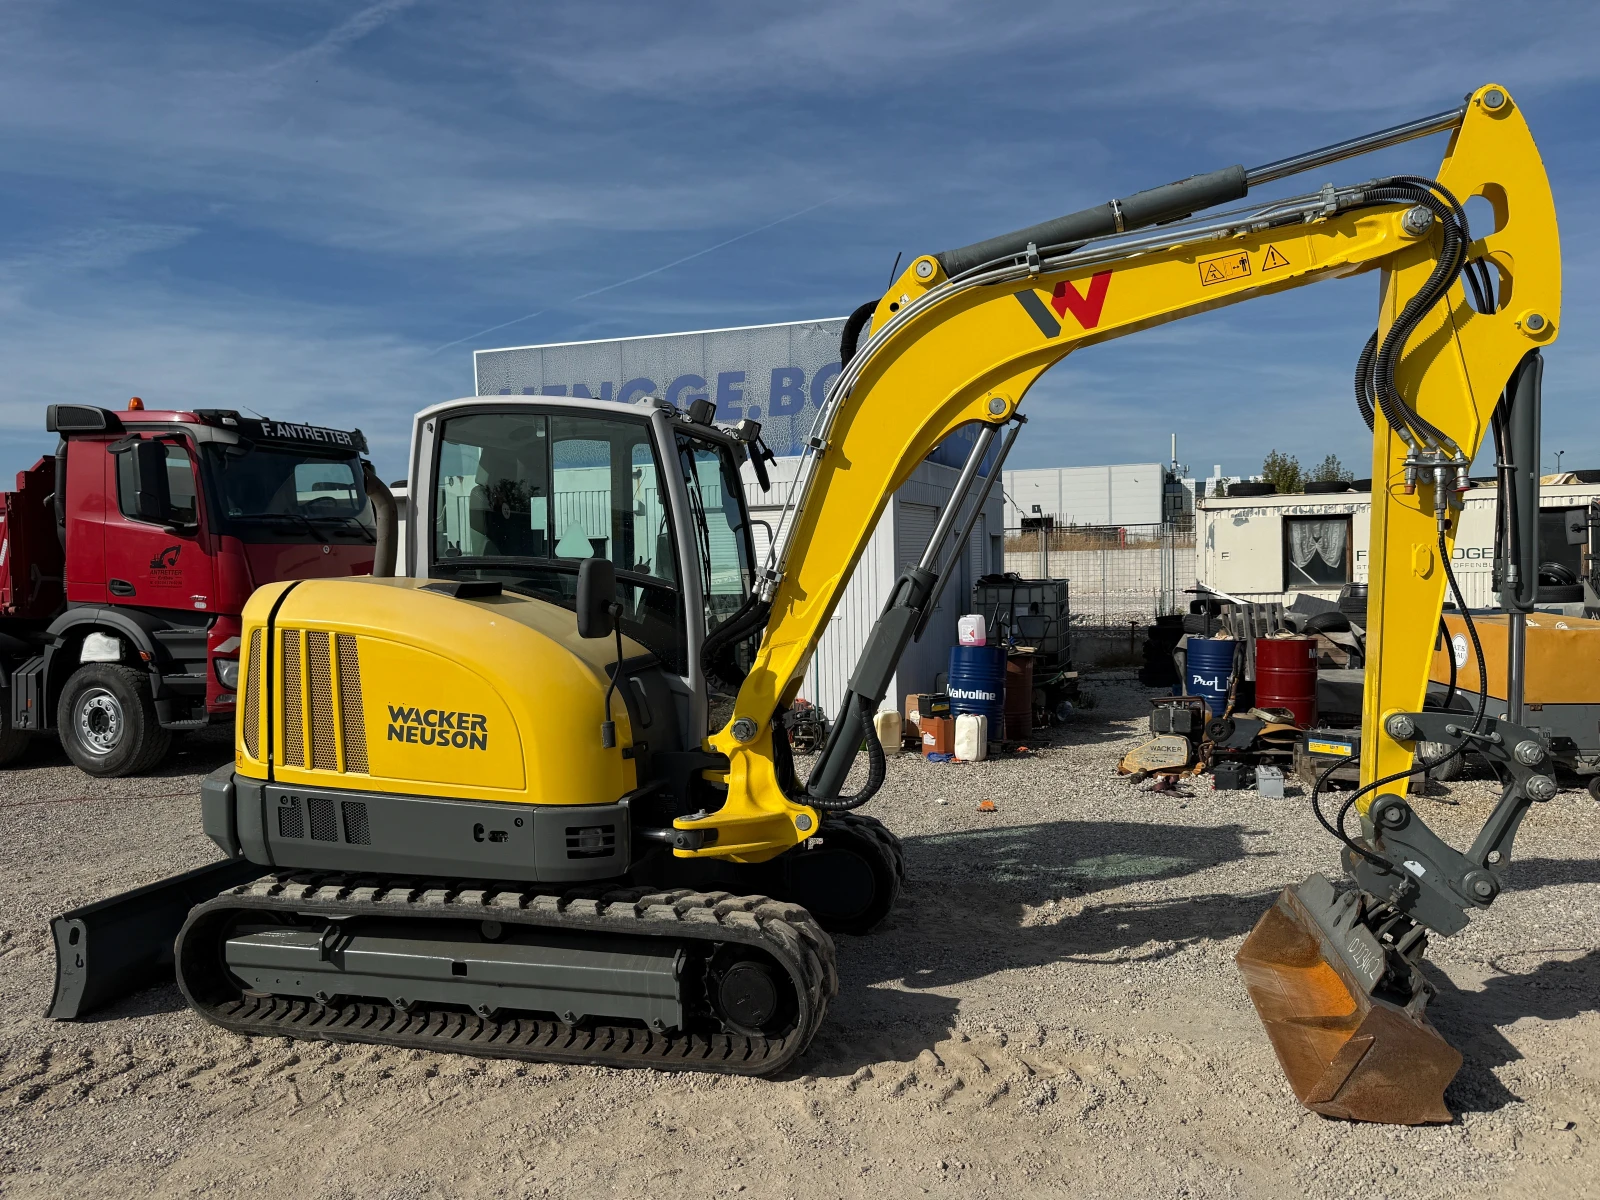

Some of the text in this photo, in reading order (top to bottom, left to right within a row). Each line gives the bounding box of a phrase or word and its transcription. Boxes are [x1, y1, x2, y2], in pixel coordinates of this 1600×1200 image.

[260, 422, 353, 446] F. ANTRETTER
[1308, 648, 1318, 659] M
[947, 684, 996, 701] Valvoline
[387, 704, 488, 733] WACKER
[387, 723, 488, 751] NEUSON
[1149, 745, 1182, 753] WACKER
